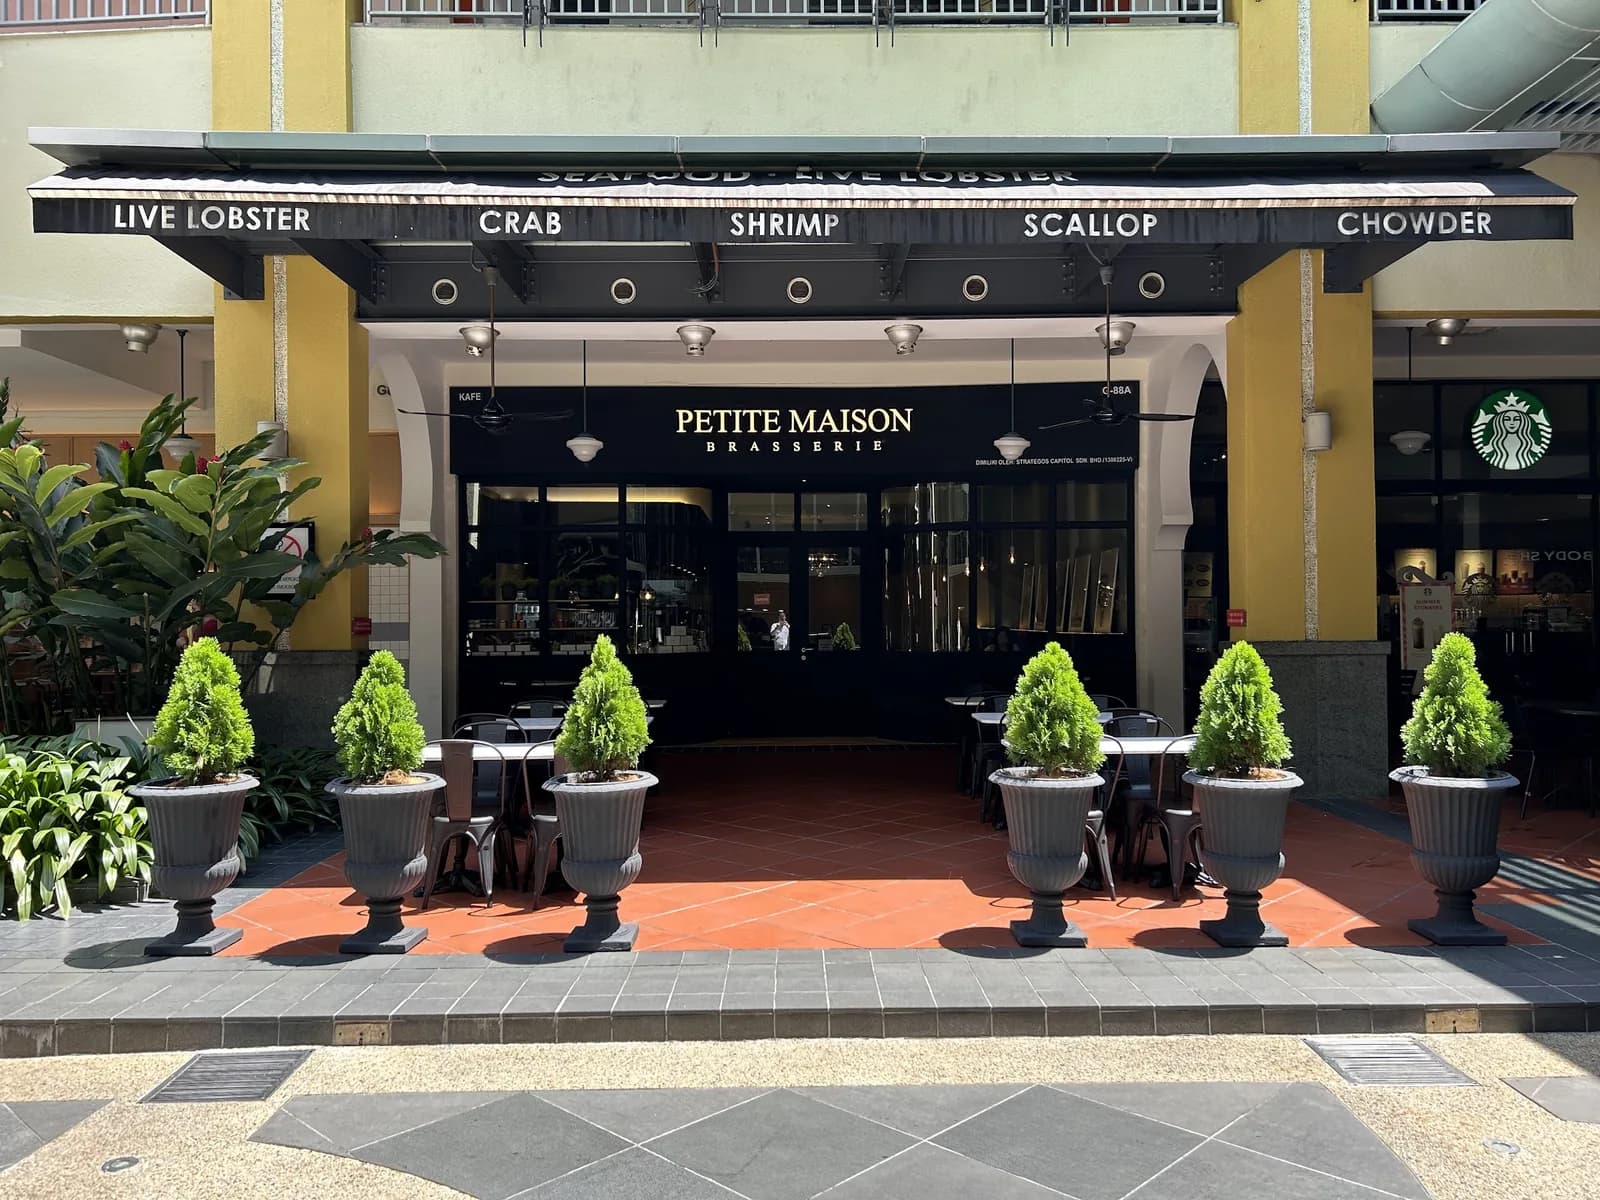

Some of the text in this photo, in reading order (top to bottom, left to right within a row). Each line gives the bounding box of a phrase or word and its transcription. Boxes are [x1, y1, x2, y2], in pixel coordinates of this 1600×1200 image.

[114, 204, 311, 231] LIVE LOBSTER
[479, 210, 562, 235] CRAB
[730, 212, 840, 237] SHRIMP
[1023, 213, 1158, 238] SCALLOP
[1337, 211, 1493, 236] CHOWDER
[459, 392, 482, 402] KAFE
[1102, 385, 1132, 396] G-88A
[675, 408, 914, 434] PETITE MAISON
[706, 440, 883, 453] BRASSERIE
[1016, 458, 1049, 466] STRATEGOS
[1049, 457, 1074, 465] CAPITOL
